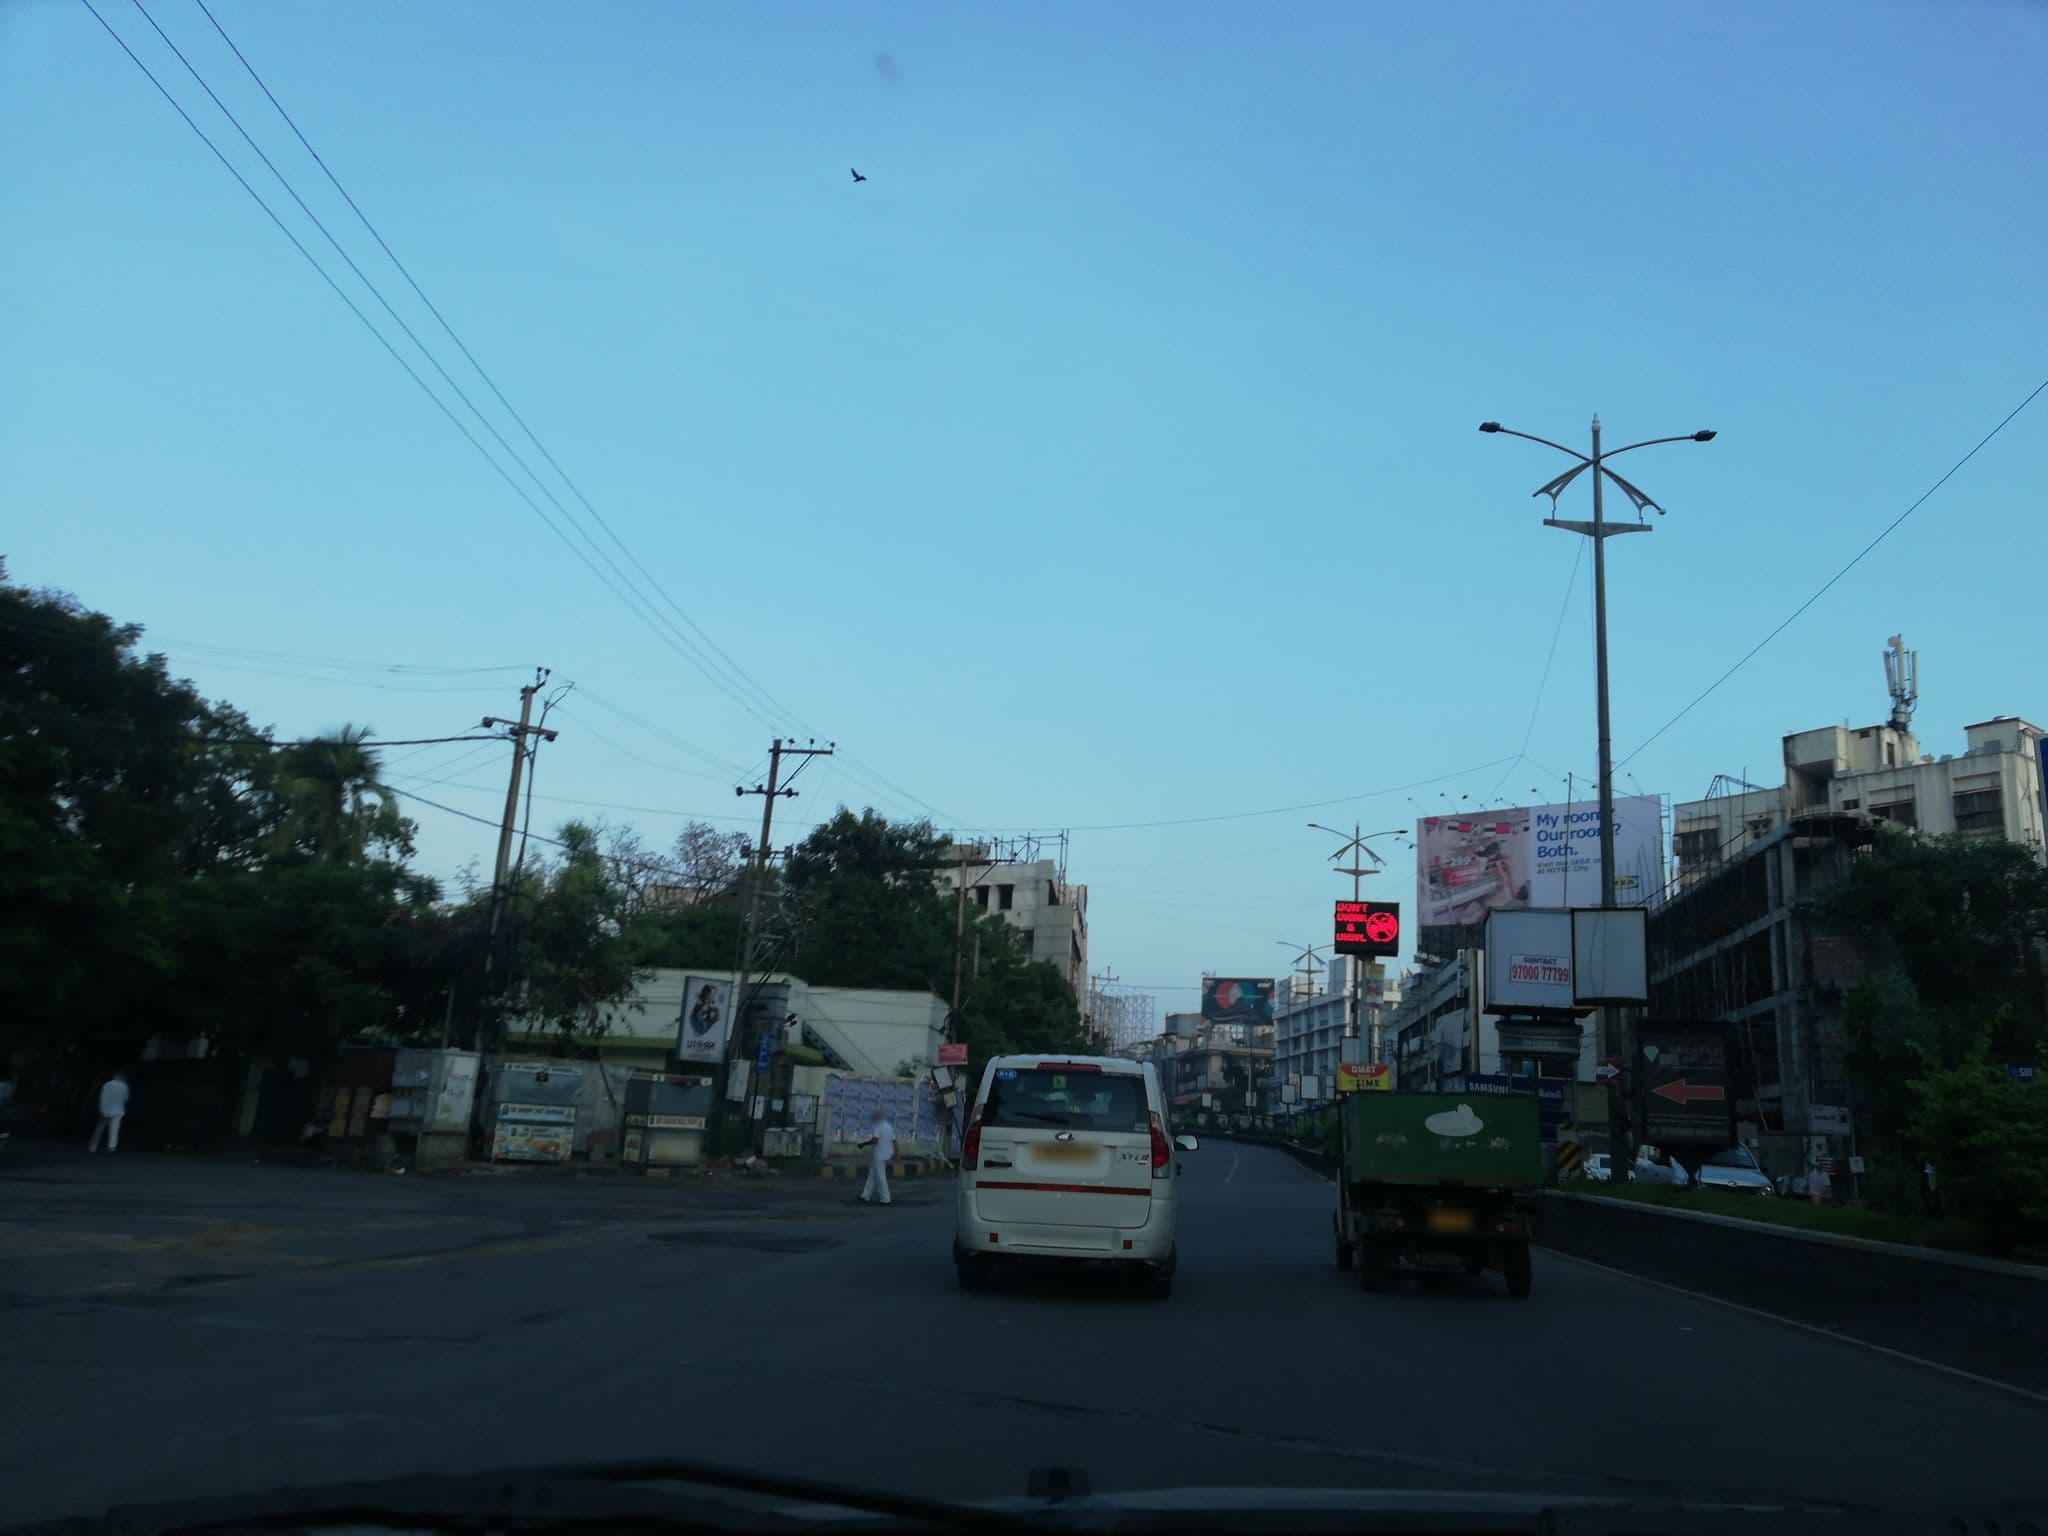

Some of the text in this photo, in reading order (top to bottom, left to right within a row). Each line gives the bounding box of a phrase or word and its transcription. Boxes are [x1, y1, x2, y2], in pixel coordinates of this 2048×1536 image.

[1537, 808, 1615, 829] My roo
[1537, 823, 1621, 842] Our roo?
[1537, 843, 1578, 858] Both.
[1512, 964, 1539, 980] 97000
